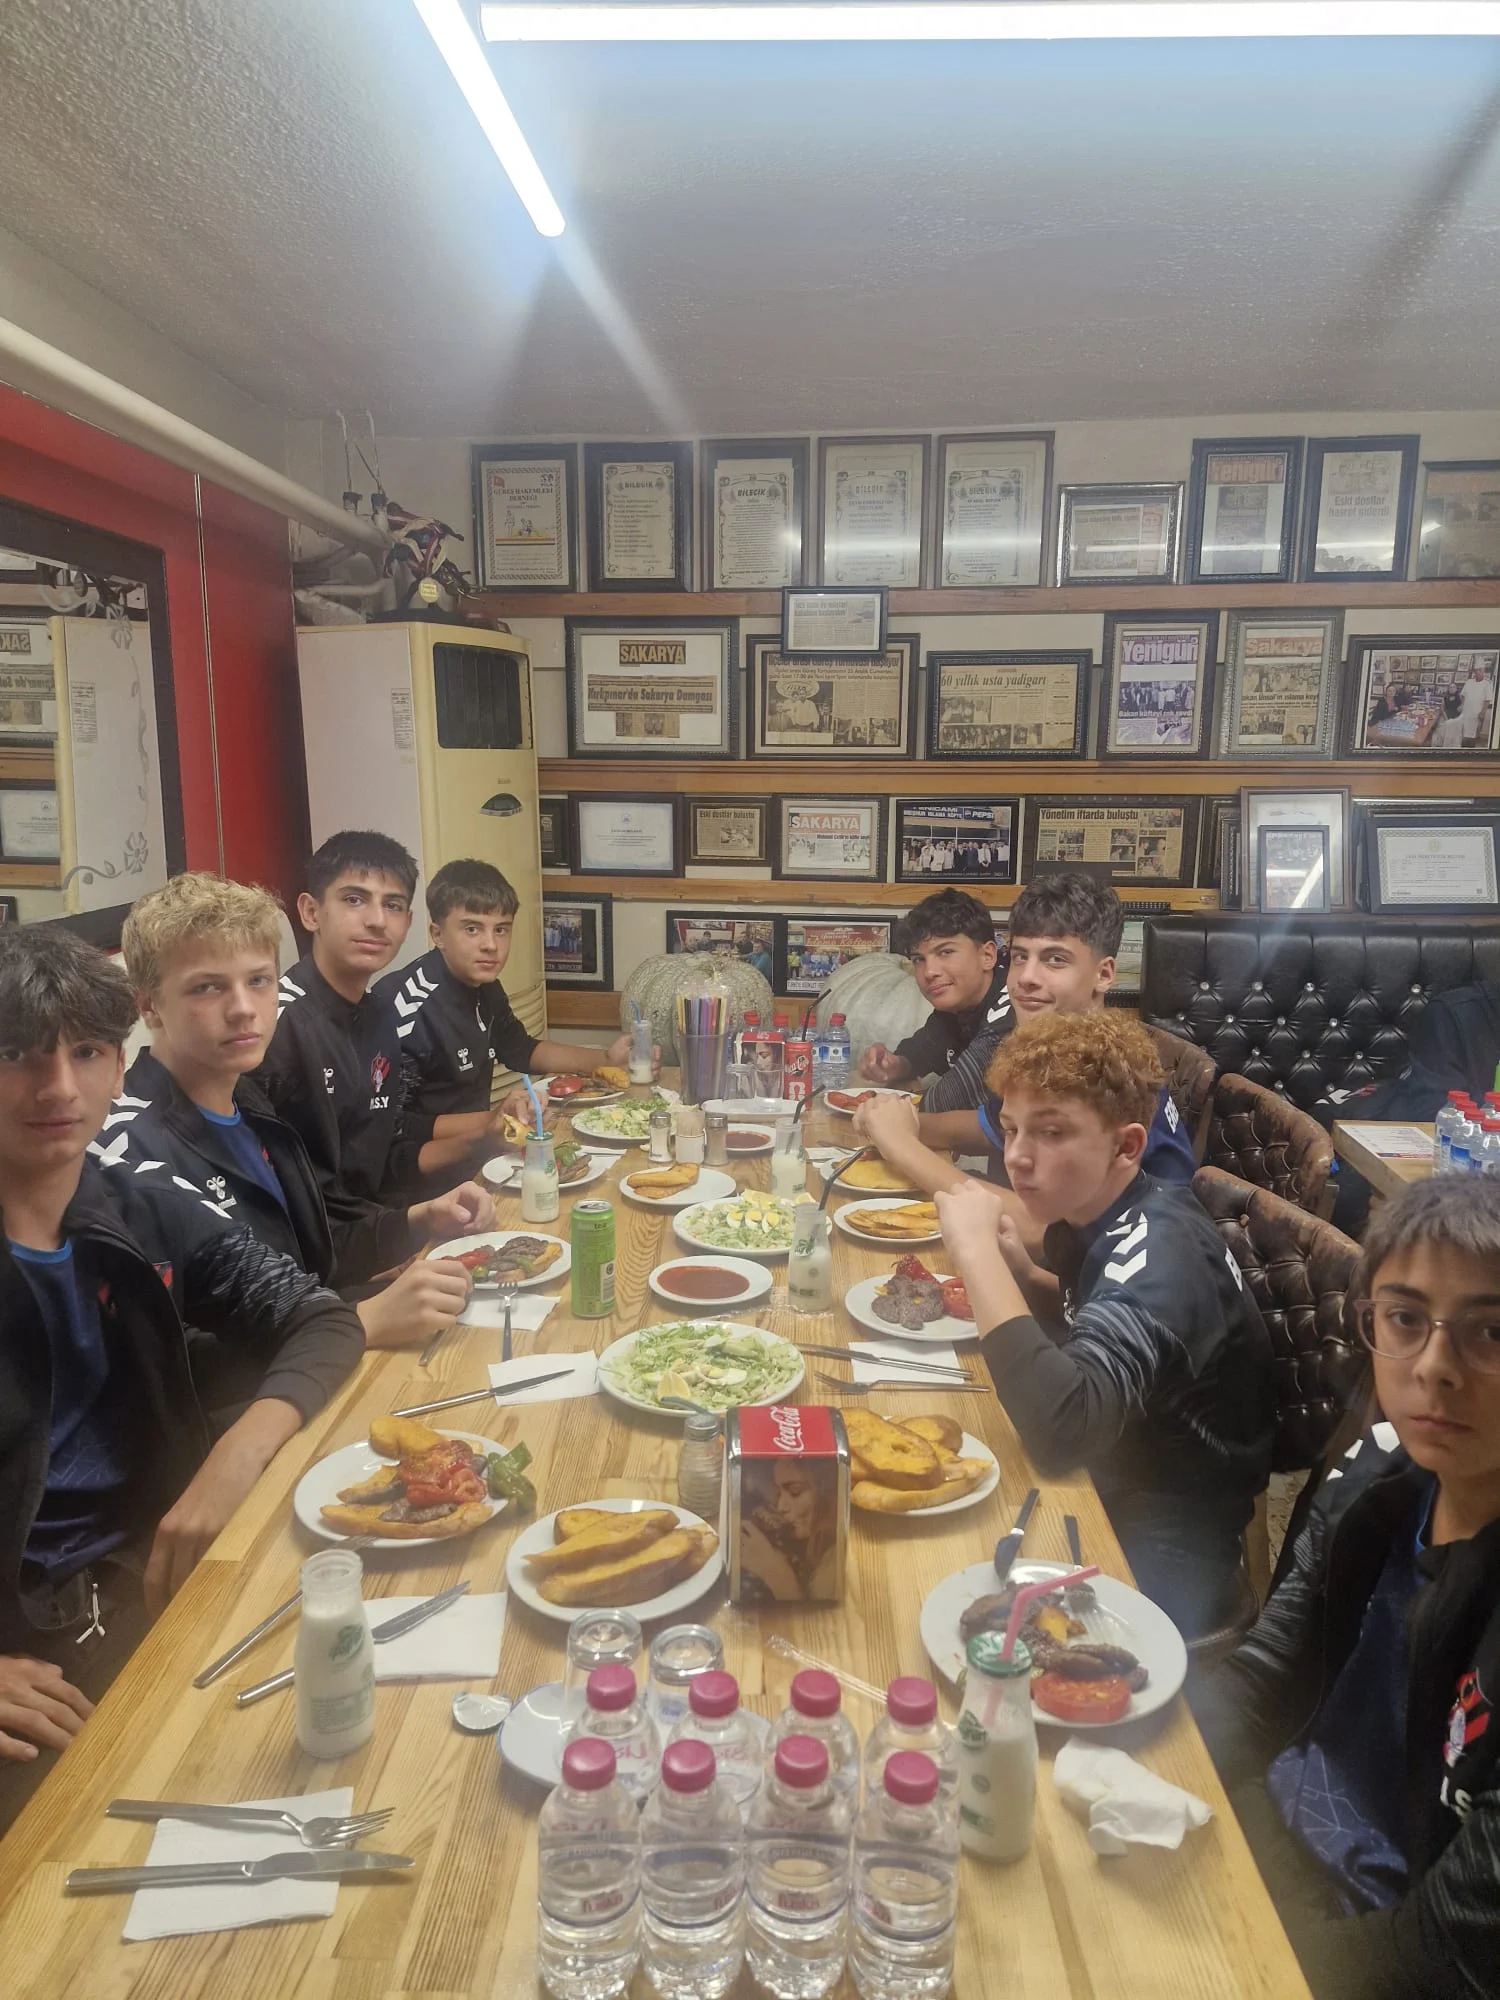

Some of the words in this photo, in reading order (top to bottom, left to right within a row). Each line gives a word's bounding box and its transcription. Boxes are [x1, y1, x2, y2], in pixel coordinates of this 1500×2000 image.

[620, 645, 685, 663] SAKARYA
[1121, 639, 1198, 664] Yenigün
[941, 675, 953, 687] 60
[954, 674, 980, 689] yıllık
[982, 675, 1003, 687] usta
[640, 687, 675, 704] Sakarya
[791, 815, 860, 829] SAKARYA
[1040, 808, 1075, 820] Yönetim
[1106, 809, 1139, 821] buluştu
